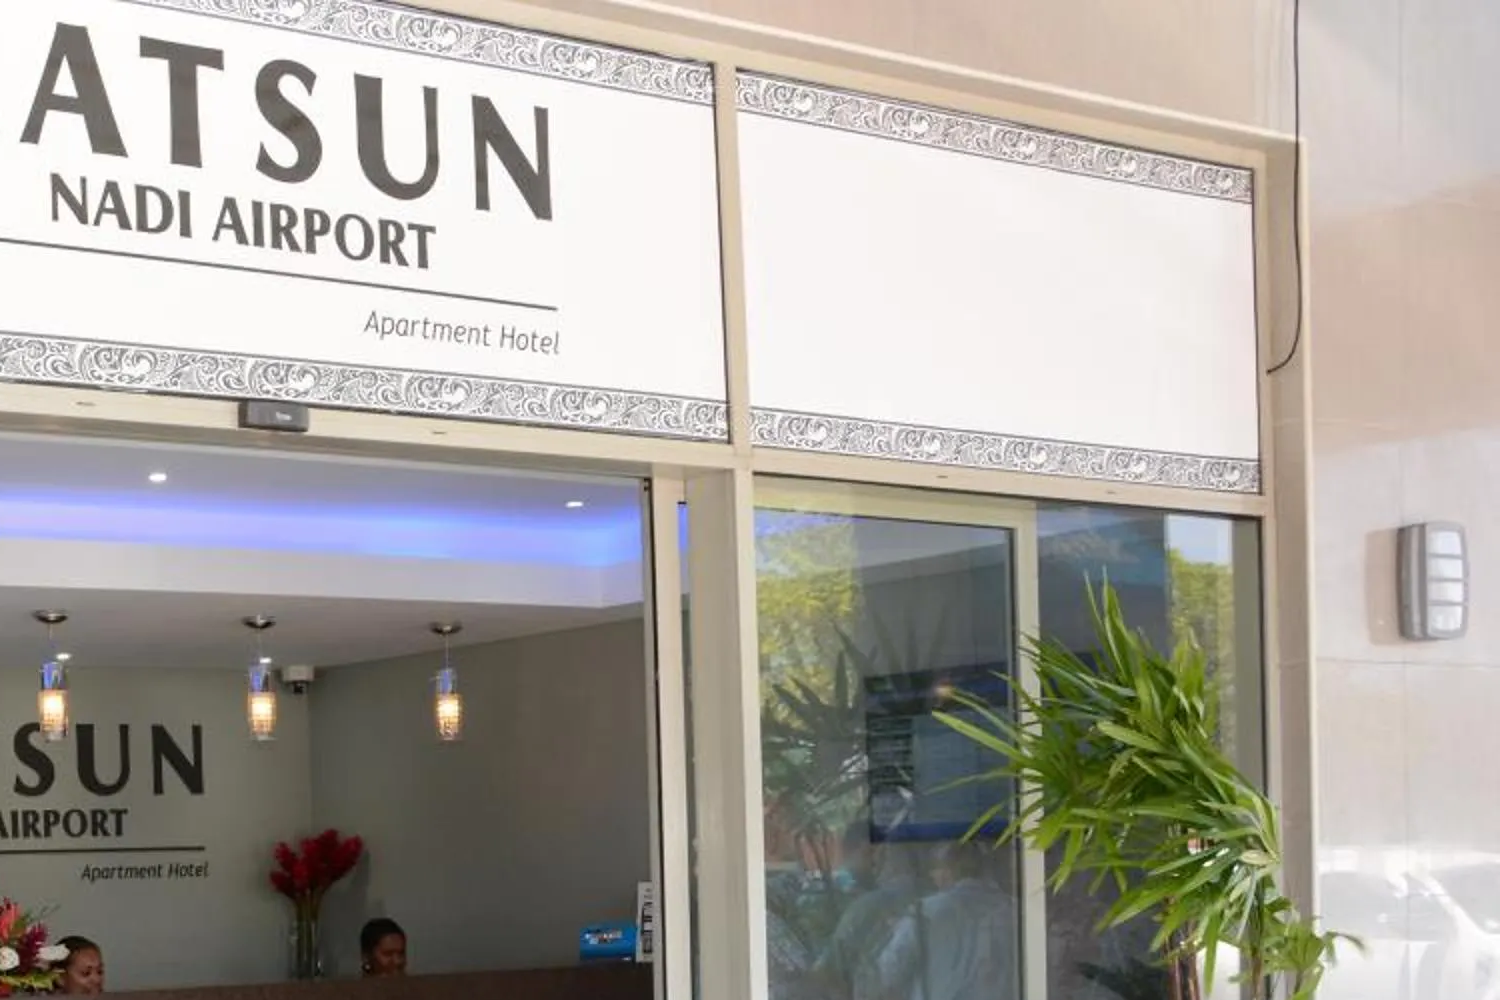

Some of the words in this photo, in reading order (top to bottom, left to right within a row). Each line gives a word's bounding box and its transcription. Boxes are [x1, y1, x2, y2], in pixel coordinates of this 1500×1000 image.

[50, 173, 192, 239] NADI
[212, 197, 437, 270] AIRPORT
[363, 310, 491, 348] Apartment
[500, 325, 560, 355] Hotel
[80, 862, 163, 884] Apartment
[167, 860, 210, 880] Hotel
